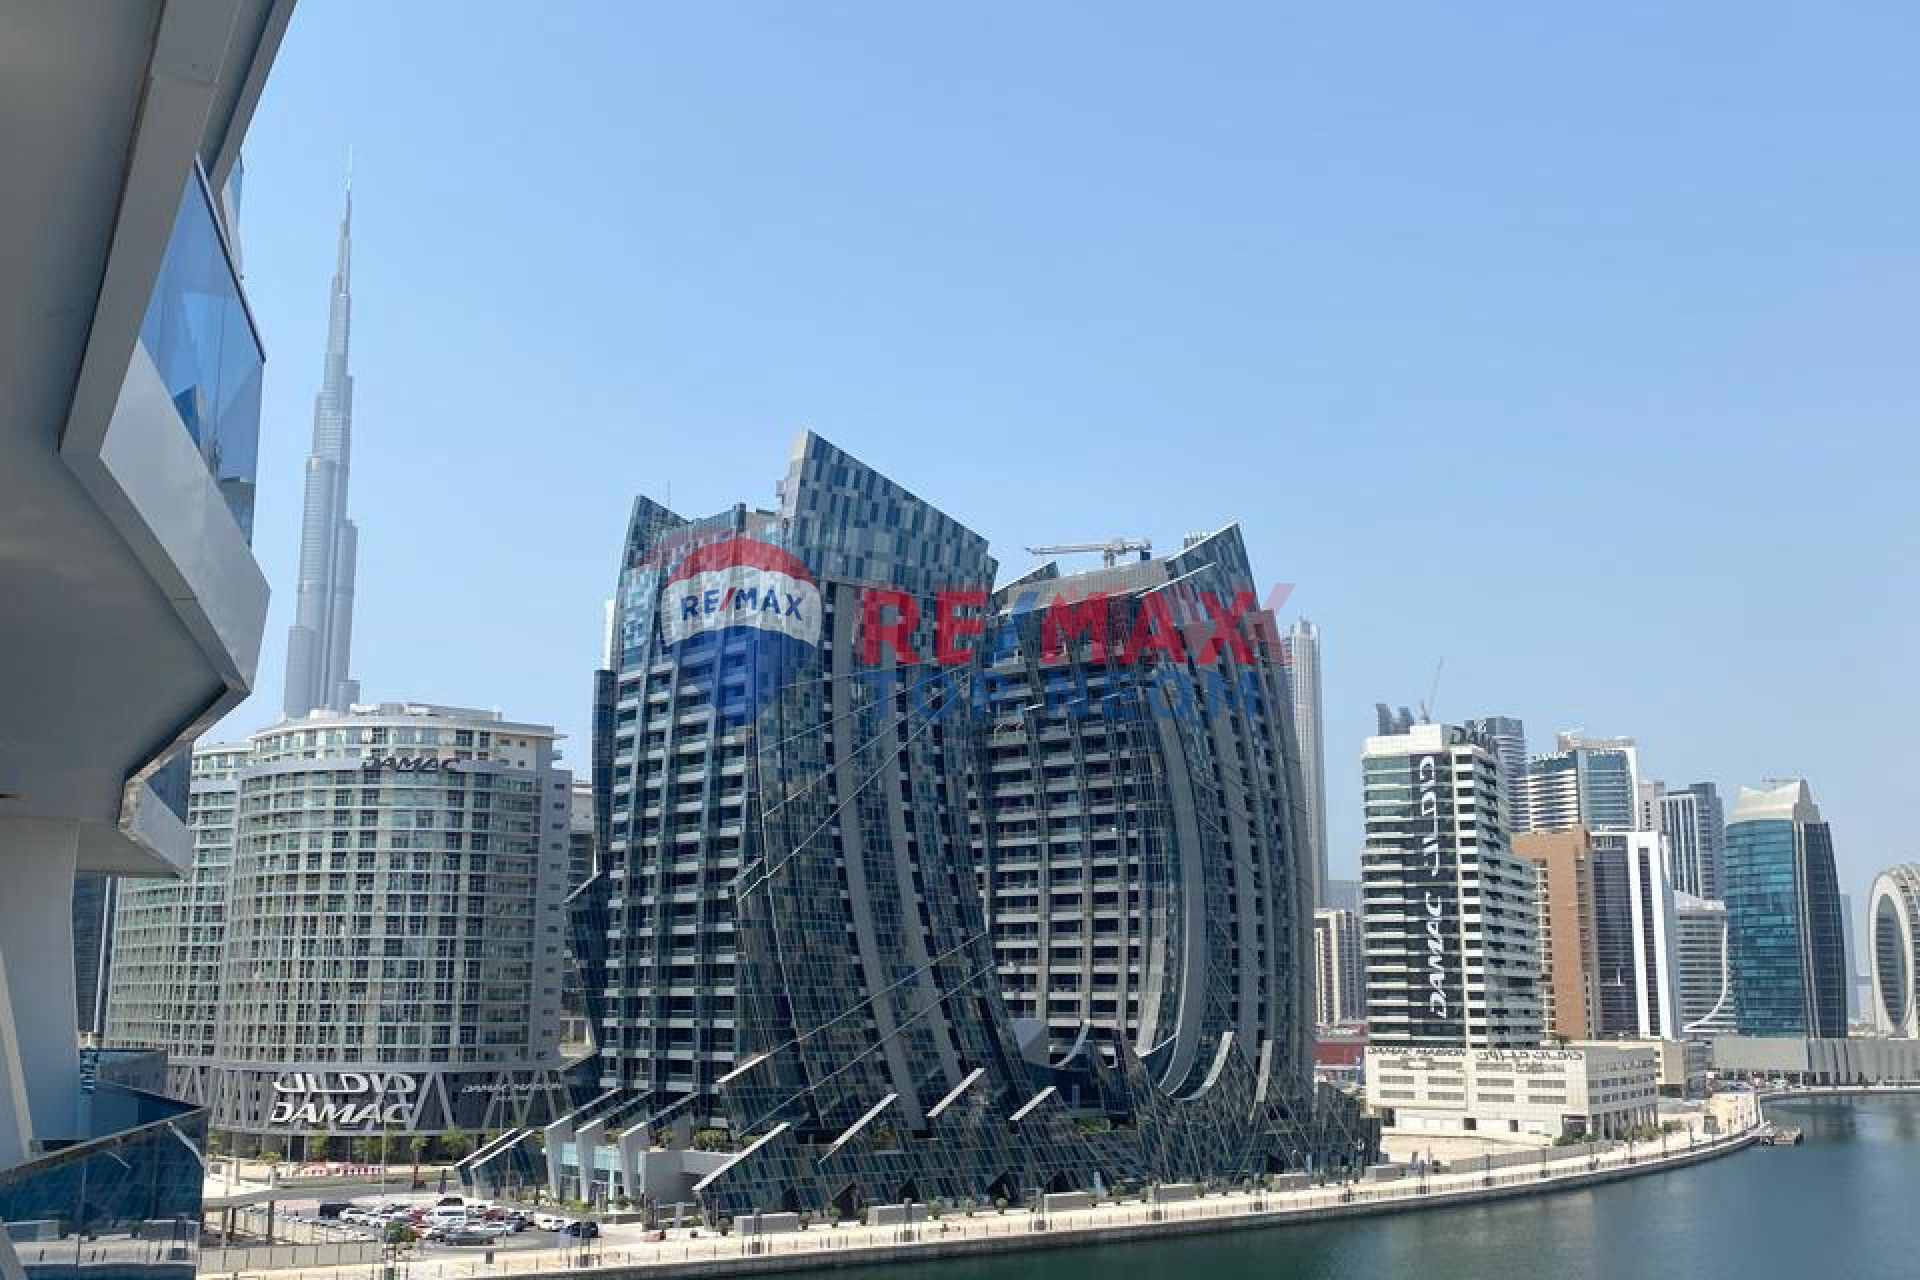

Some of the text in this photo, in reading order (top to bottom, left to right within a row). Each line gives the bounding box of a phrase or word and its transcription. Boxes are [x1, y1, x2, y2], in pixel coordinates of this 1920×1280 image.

[361, 757, 460, 771] DAMAC
[1425, 891, 1447, 1020] DAMAC
[269, 1103, 414, 1123] DAMAC
